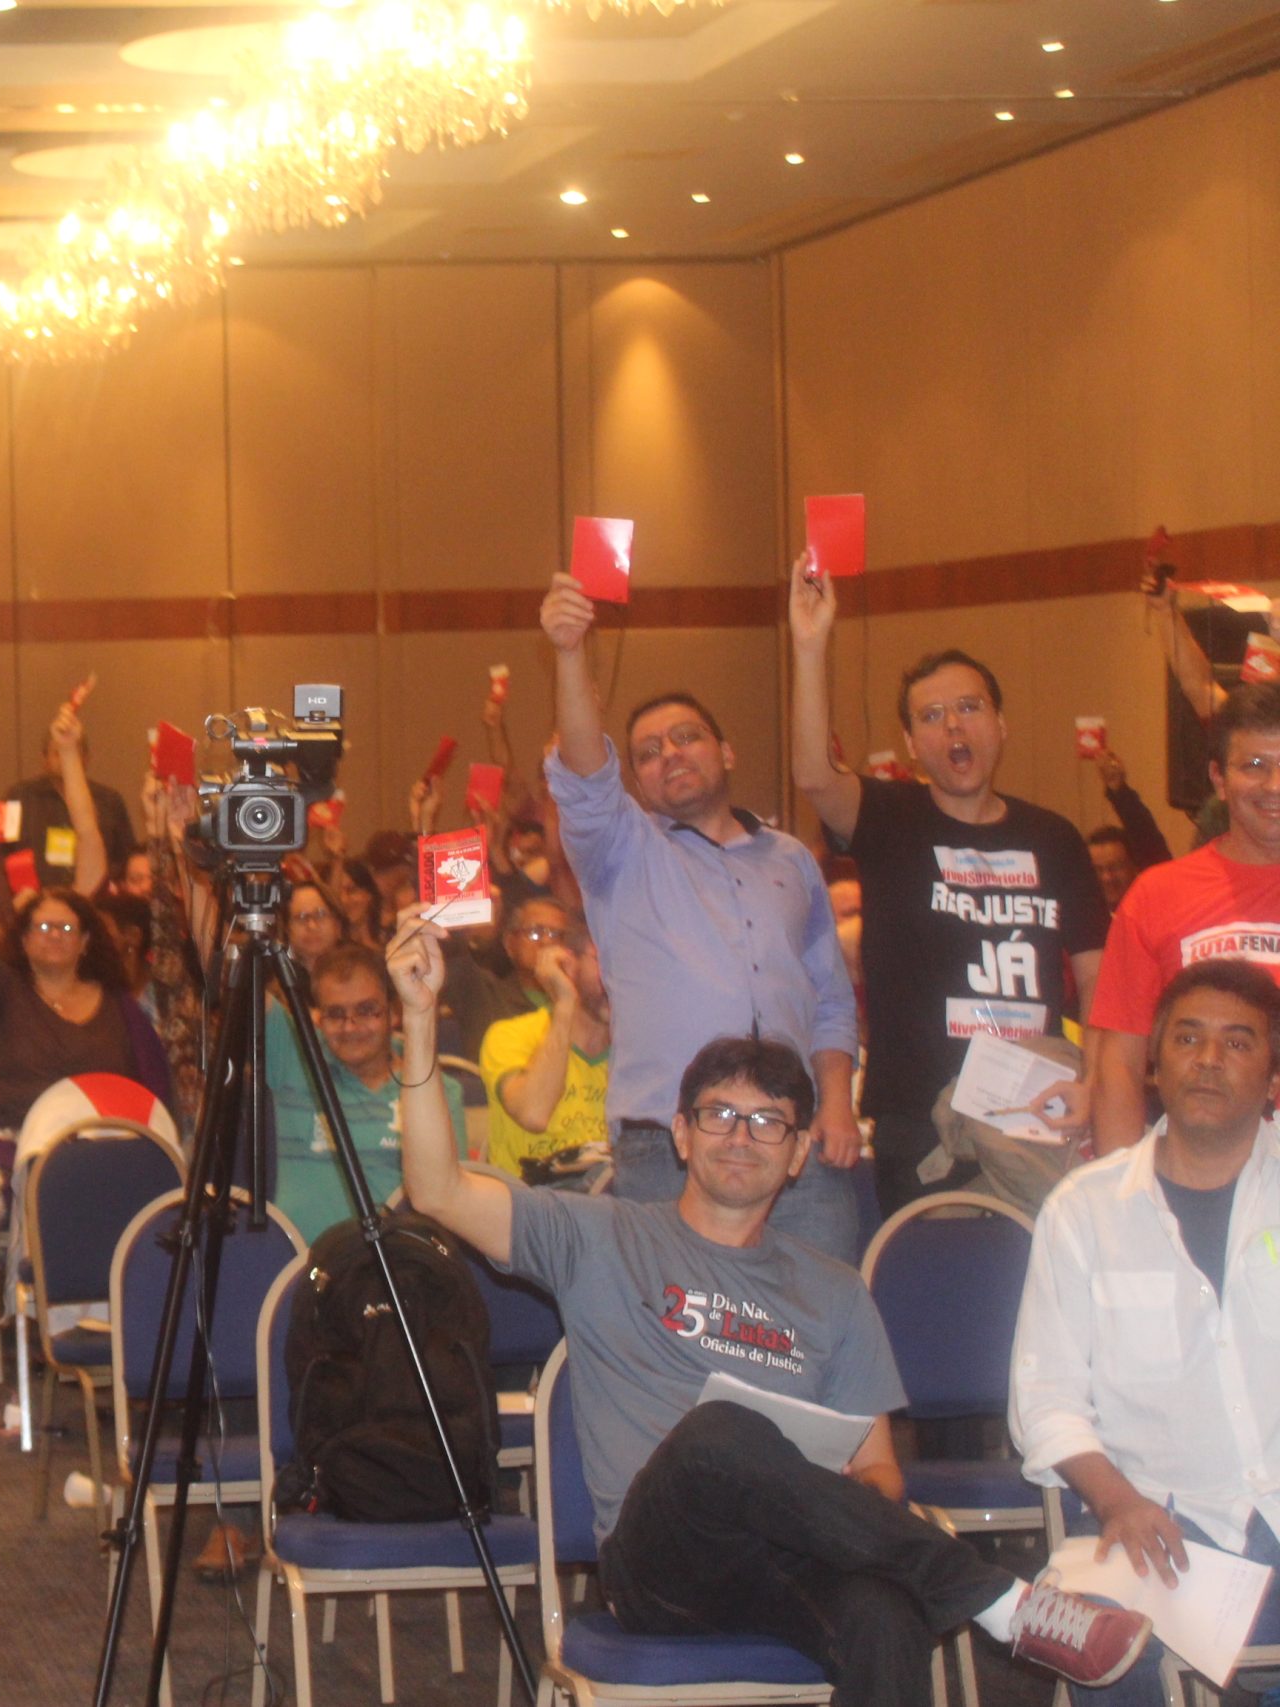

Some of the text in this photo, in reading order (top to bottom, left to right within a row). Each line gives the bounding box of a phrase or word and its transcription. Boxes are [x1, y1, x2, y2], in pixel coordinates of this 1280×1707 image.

[308, 696, 327, 704] HD
[931, 881, 1058, 929] REAJUSTE
[967, 929, 1039, 997] JÁ
[661, 1284, 707, 1337] 25
[711, 1293, 737, 1313] Dia
[700, 1335, 802, 1375] Oficiais de Justiça
[709, 1310, 805, 1360] de Lutas dos
